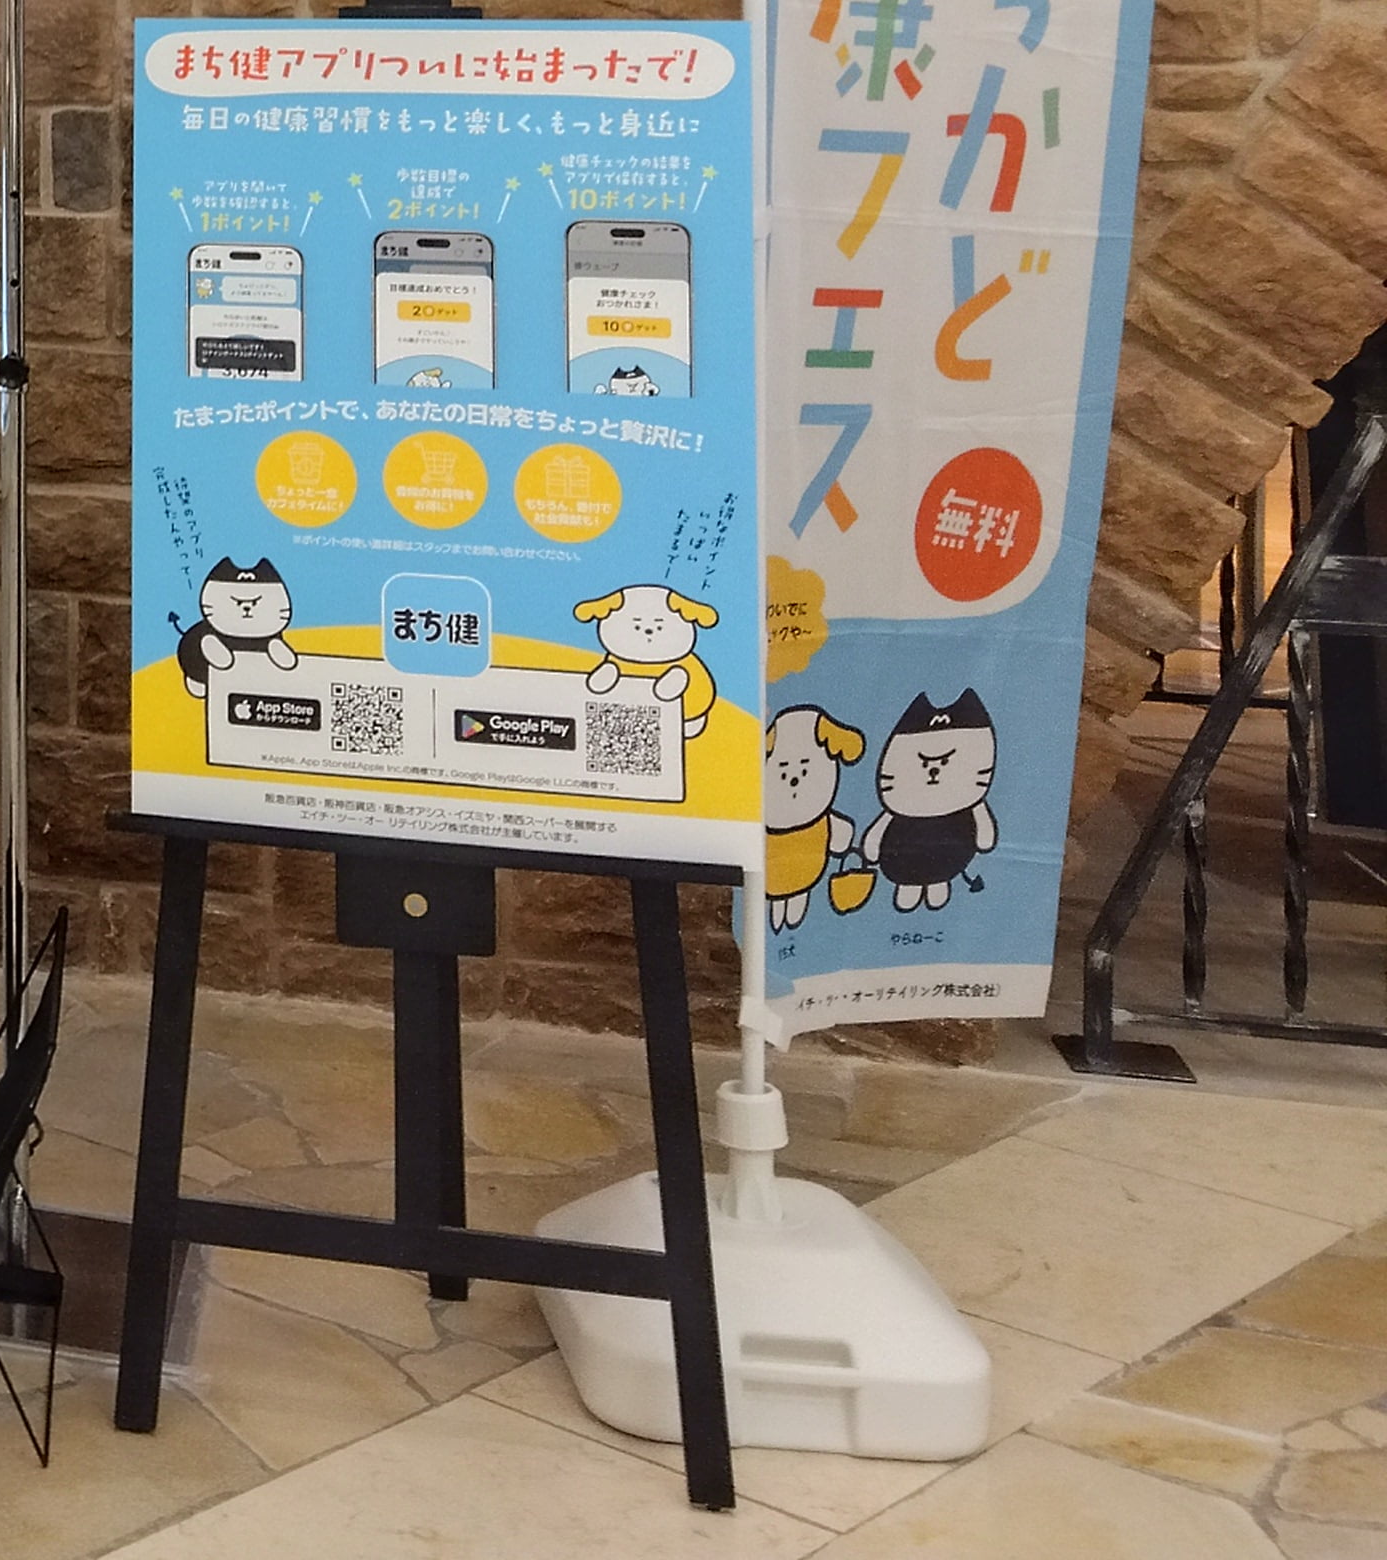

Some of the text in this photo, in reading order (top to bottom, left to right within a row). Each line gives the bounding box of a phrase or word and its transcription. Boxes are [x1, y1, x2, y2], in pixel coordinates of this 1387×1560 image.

[174, 45, 699, 85] まち健アプリついに始まったで!
[182, 103, 700, 139] 毎日の健康習慣をもっと楽しく、もっと身近に
[387, 199, 479, 221] 2ポイント!
[568, 188, 686, 211] 10ポイント!
[201, 212, 290, 233] 1ポイント!
[603, 320, 619, 332] 10
[174, 399, 704, 453] たまったポイントで、あなたの日常をちょっと贅沢に!
[931, 487, 1020, 558] 無料
[392, 607, 481, 647] まち健
[255, 700, 314, 717] App Store
[489, 714, 569, 738] Google Play
[490, 731, 546, 746] で手に入れよう
